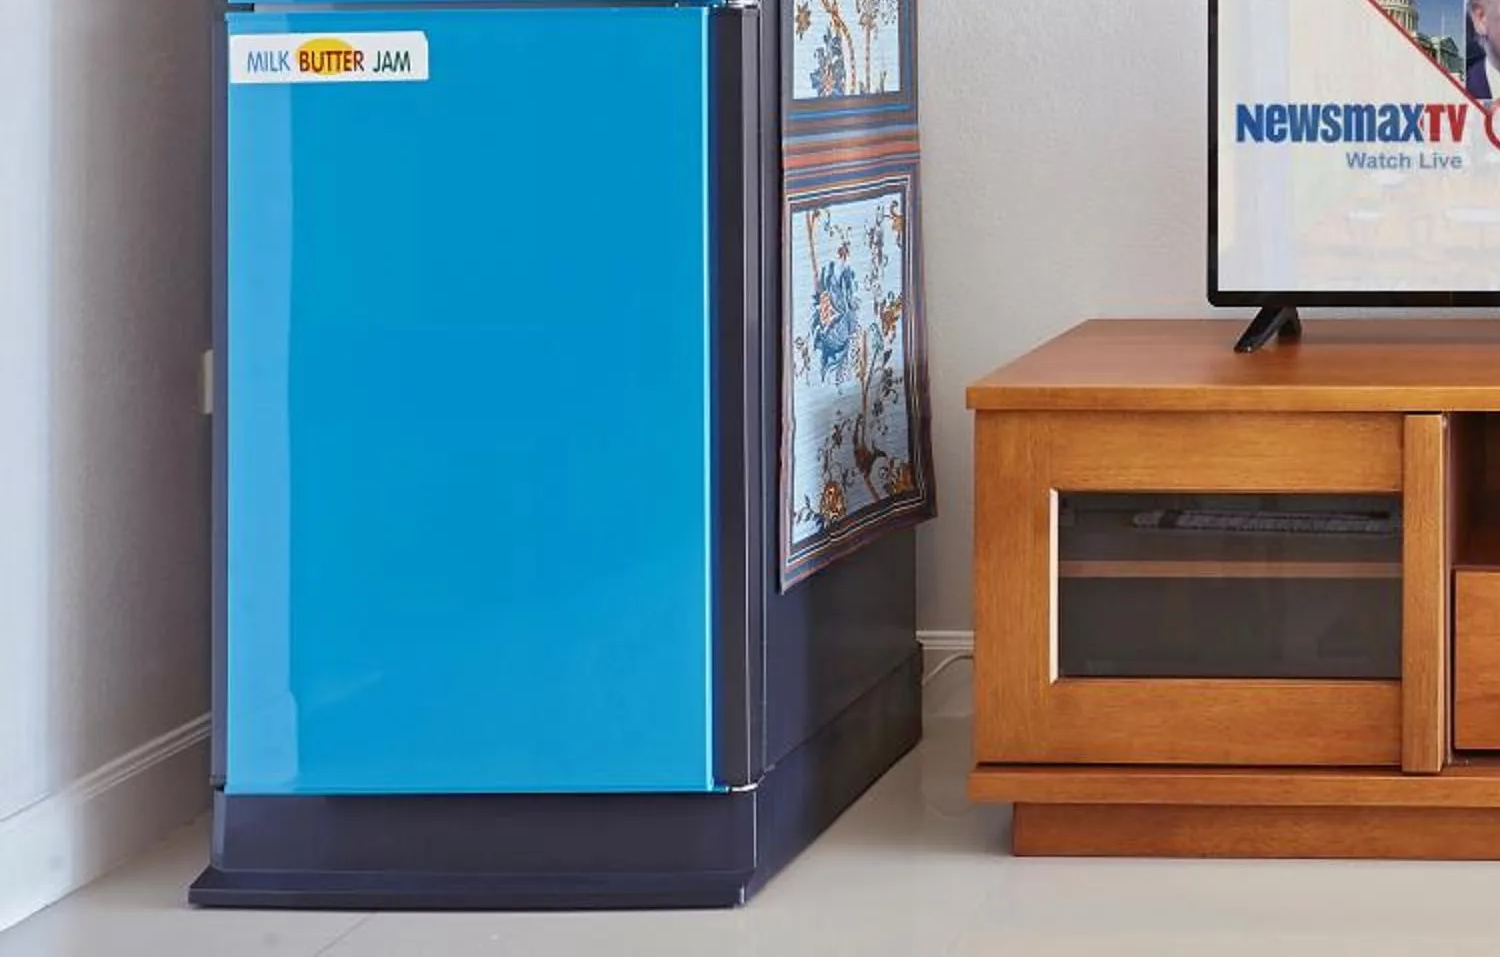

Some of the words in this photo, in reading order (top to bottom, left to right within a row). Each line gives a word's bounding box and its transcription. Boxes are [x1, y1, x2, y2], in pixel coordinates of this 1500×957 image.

[247, 50, 291, 73] MILK
[300, 50, 365, 73] BUTTER
[372, 50, 411, 73] JAM
[1346, 152, 1411, 169] Watch
[1419, 152, 1462, 170] Live
